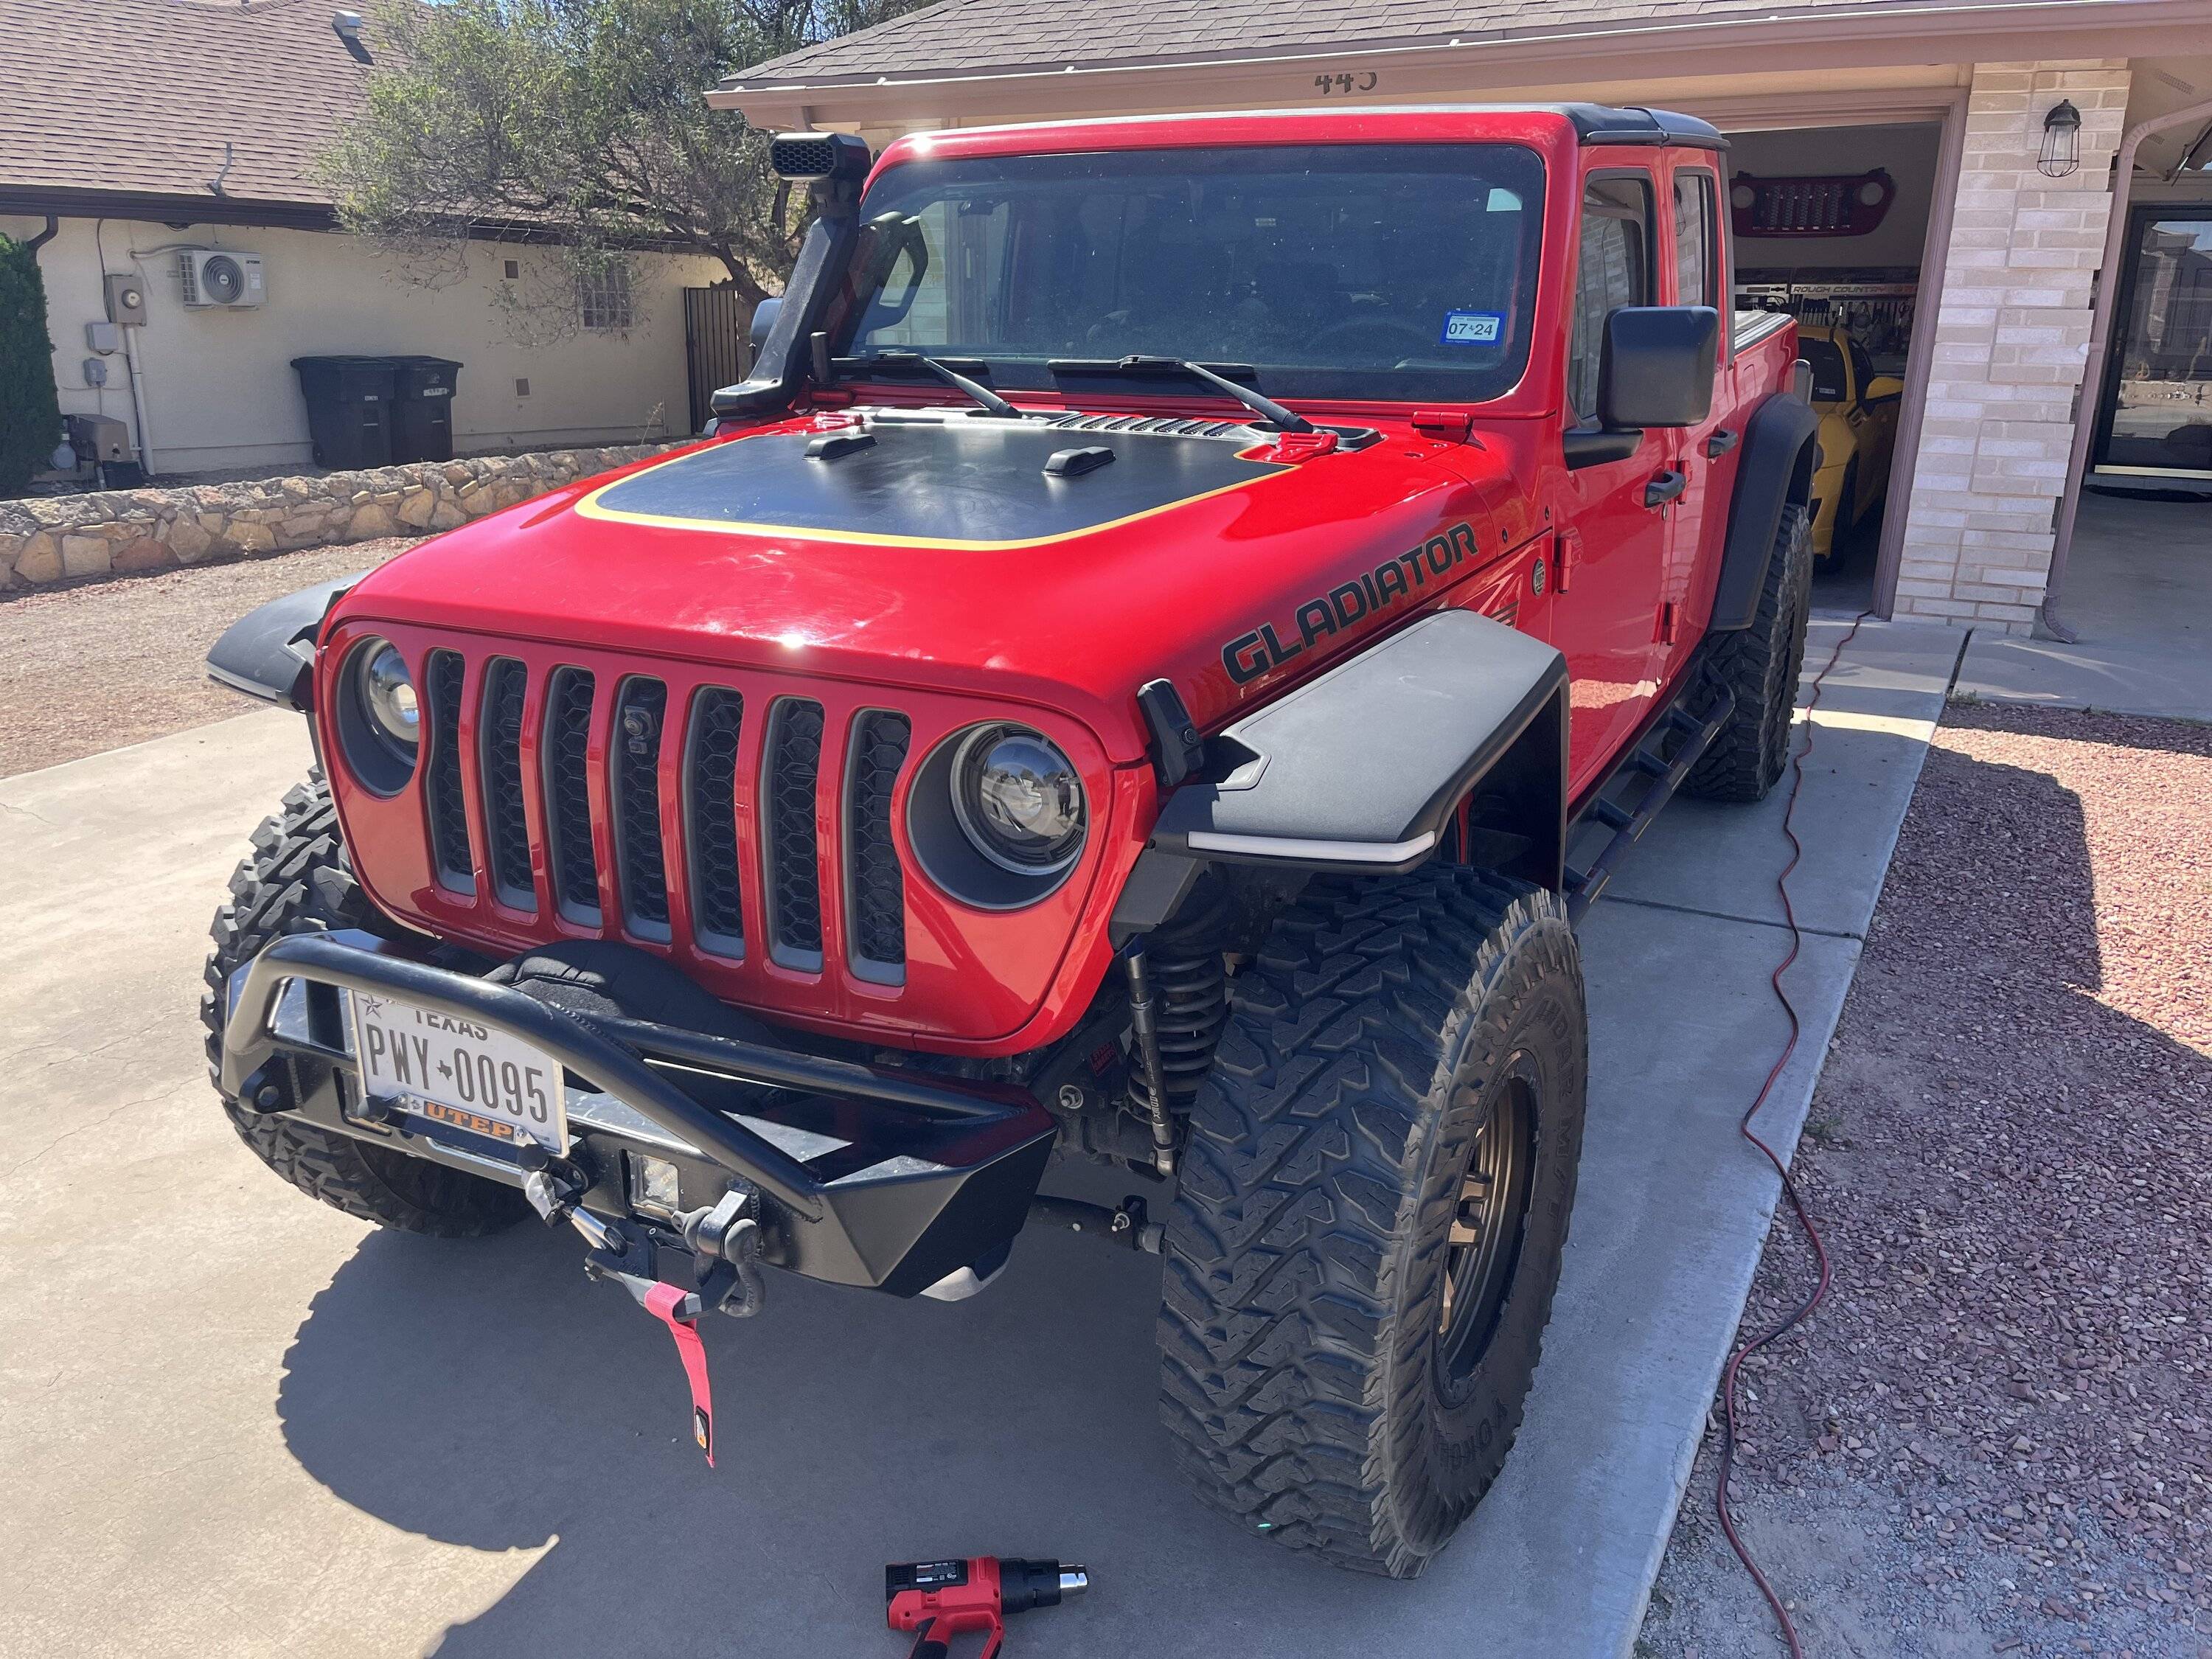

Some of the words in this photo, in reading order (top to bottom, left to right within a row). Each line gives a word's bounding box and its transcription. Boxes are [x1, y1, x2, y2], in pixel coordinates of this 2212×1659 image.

[1792, 285, 1830, 294] ROUGH
[1832, 285, 1885, 294] COUNTRY
[1448, 323, 1468, 335] 07
[1474, 323, 1493, 335] 24
[1220, 521, 1478, 687] GLADIATOR
[366, 1023, 431, 1091] PWY
[453, 1048, 548, 1123] 0095
[426, 1101, 513, 1137] UTEP
